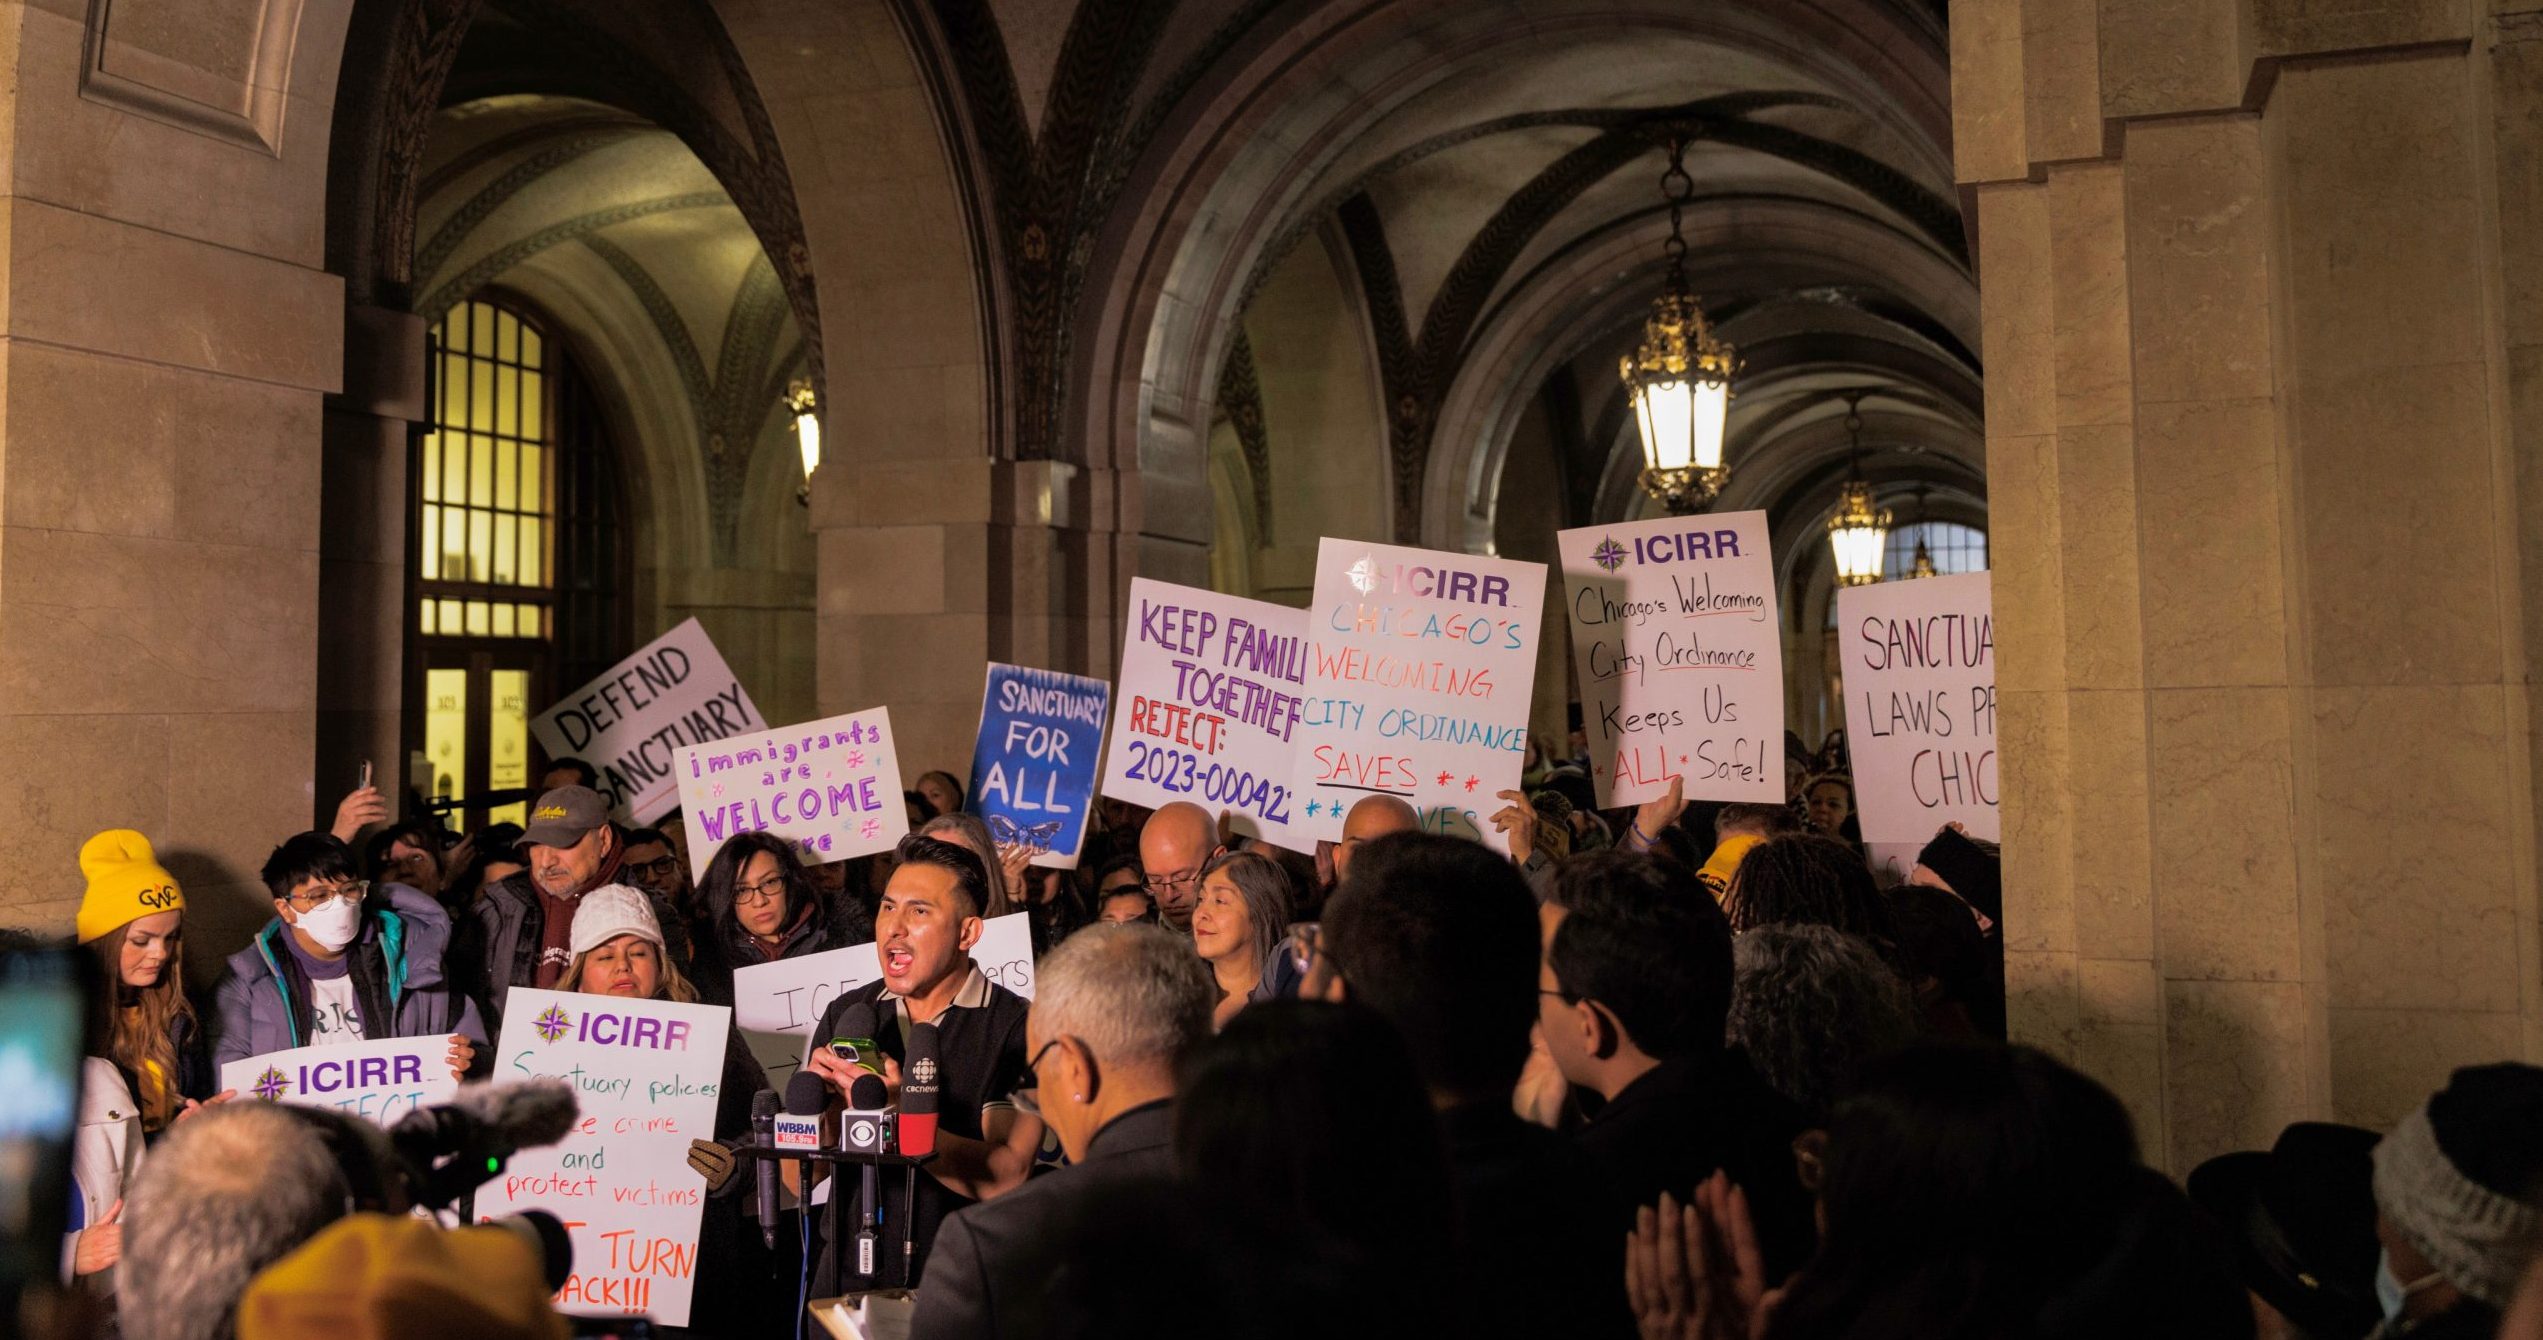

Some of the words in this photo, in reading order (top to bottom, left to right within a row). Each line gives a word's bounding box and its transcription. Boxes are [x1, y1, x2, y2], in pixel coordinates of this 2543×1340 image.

[1634, 529, 1740, 565] ICIRR
[1392, 564, 1511, 608] ICIRR
[1576, 586, 1667, 627] Chicago's
[1672, 572, 1767, 622] Welcoming
[1140, 599, 1217, 657] KEEP
[1223, 617, 1308, 685] FAMILI
[1331, 603, 1522, 650] CHICAGO'S
[1862, 614, 1993, 670] SANCTUA
[1316, 642, 1493, 700] WELCOMING
[1590, 641, 1645, 687] City
[1656, 631, 1756, 668] Ordinance
[554, 646, 691, 753] DEFEND
[999, 679, 1106, 730] SANCTUARY
[1303, 697, 1365, 731] CITY
[1379, 708, 1527, 752] ORDINANCE
[1600, 700, 1684, 740] Keeps
[1703, 684, 1738, 724] Us
[1867, 690, 1952, 737] LAWS
[690, 720, 880, 778] immigrants
[1005, 720, 1070, 767] FOR
[1130, 695, 1226, 755] REJECT:
[762, 763, 811, 786] are
[979, 760, 1072, 814] ALL
[1125, 740, 1292, 825] 2023-00042
[1314, 745, 1418, 788] SAVES
[1612, 745, 1682, 790] ALL
[1697, 738, 1765, 783] Safe!
[1911, 749, 1999, 808] CHIC
[698, 776, 882, 842] WELCOME
[1418, 805, 1482, 843] VES
[984, 958, 1029, 989] ers
[578, 1012, 692, 1052] ICIRR
[299, 1054, 422, 1095] ICIRR
[649, 1073, 718, 1105] policies
[614, 1115, 679, 1134] crime
[777, 1122, 816, 1135] WBBM
[562, 1146, 604, 1170] and
[506, 1172, 598, 1201] protect
[613, 1179, 699, 1206] victims
[600, 1229, 696, 1279] TURN
